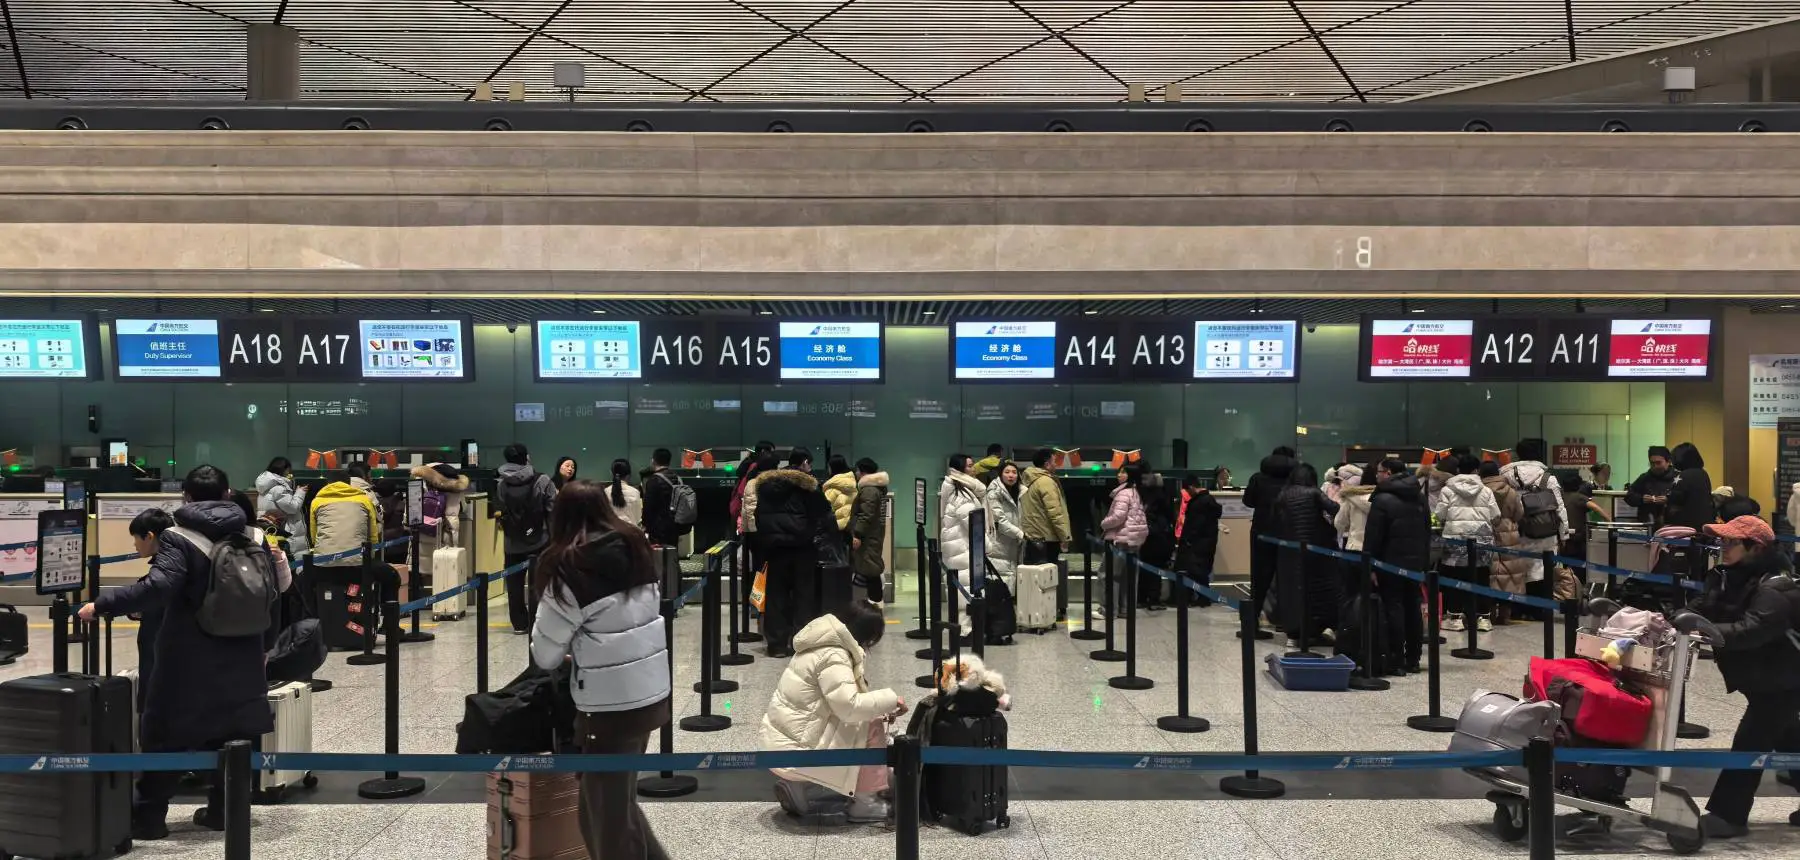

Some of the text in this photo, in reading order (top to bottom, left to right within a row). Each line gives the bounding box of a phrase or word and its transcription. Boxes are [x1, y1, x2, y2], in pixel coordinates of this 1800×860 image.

[144, 352, 193, 360] Duty Supervisor
[150, 341, 187, 351] 值班主任
[230, 334, 282, 364] A18
[299, 334, 350, 365] A17
[651, 335, 703, 366] A16
[720, 335, 771, 366] A15
[813, 344, 847, 353] 经济舱
[989, 344, 1022, 353] 经济舱
[1064, 335, 1116, 366] A14
[1133, 335, 1185, 365] A13
[1403, 337, 1440, 354] 哈快线
[1481, 333, 1534, 364] A12
[1551, 333, 1598, 364] A11
[1640, 336, 1678, 353] 哈快线
[982, 354, 1010, 362] Economy
[1559, 447, 1591, 459] 消火栓
